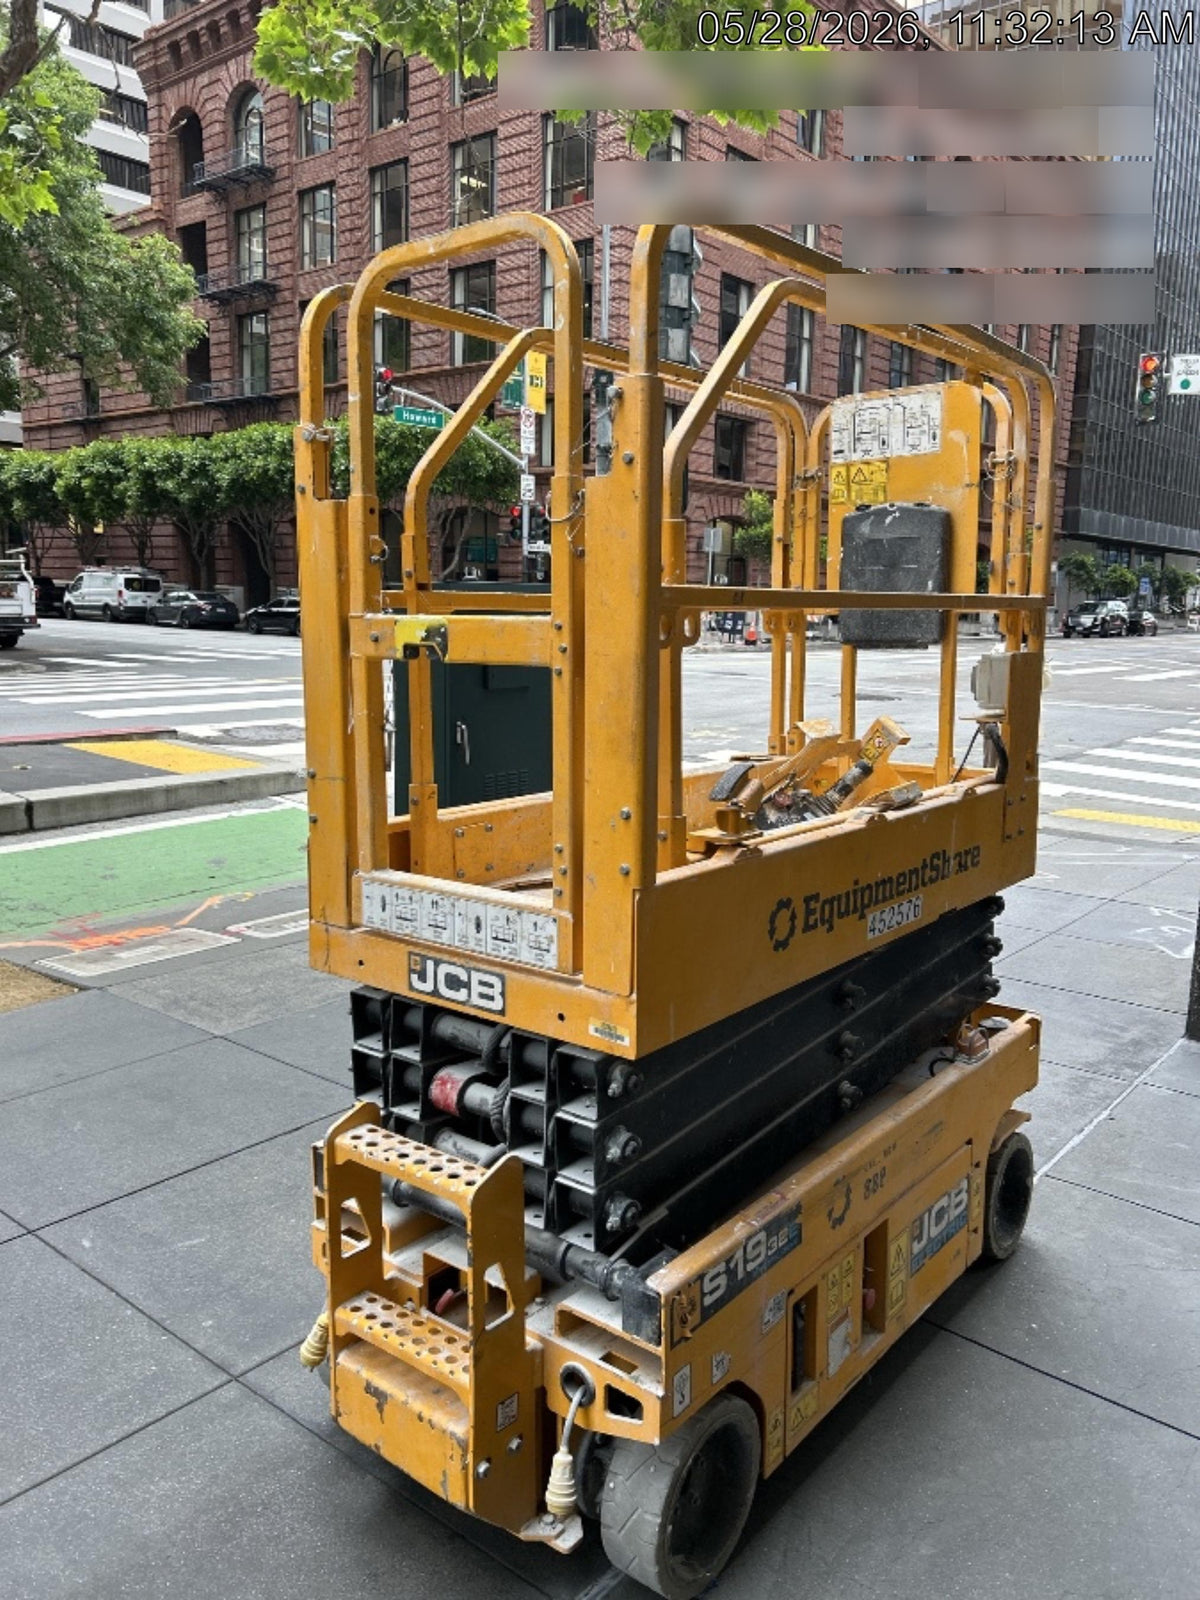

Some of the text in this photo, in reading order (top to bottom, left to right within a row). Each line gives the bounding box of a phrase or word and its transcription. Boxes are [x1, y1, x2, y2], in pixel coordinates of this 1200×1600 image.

[403, 411, 436, 424] Howard
[802, 845, 981, 935] EquipmentShare
[868, 902, 921, 937] 452576
[411, 959, 504, 1011] JCB
[911, 1177, 969, 1254] JCB
